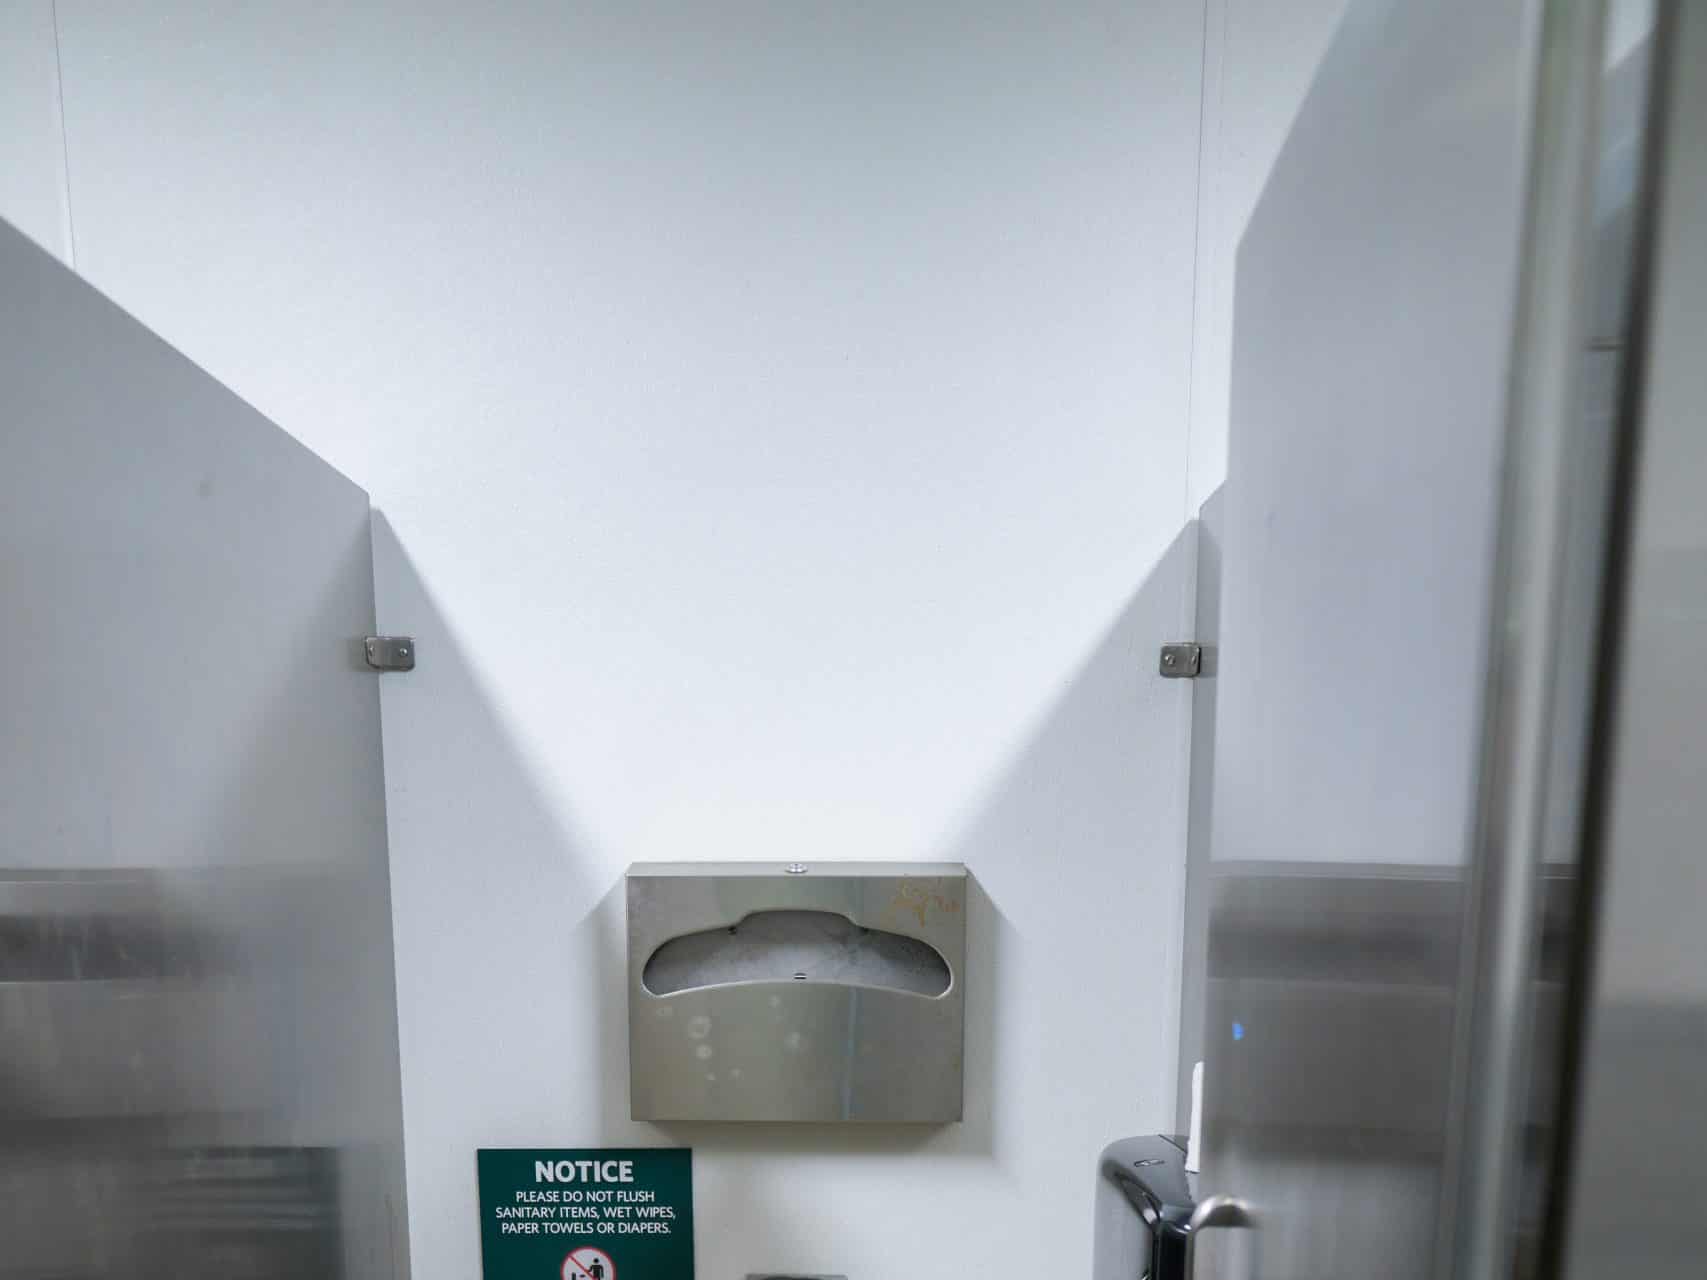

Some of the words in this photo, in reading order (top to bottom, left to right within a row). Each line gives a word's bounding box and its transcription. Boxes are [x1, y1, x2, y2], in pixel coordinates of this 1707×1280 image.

[535, 1160, 634, 1183] NOTICE
[515, 1191, 560, 1203] PLEASE
[563, 1191, 583, 1203] DO
[586, 1191, 614, 1203] NOT
[616, 1191, 655, 1203] FLUSH
[495, 1207, 556, 1219] SANITARY
[559, 1207, 600, 1220] ITEMS,
[603, 1206, 632, 1218] WET
[636, 1206, 676, 1219] WIPES,
[501, 1222, 540, 1234] PAPER
[543, 1222, 594, 1234] TOWELS
[597, 1222, 615, 1234] OR
[618, 1222, 672, 1234] DIAPERS.
